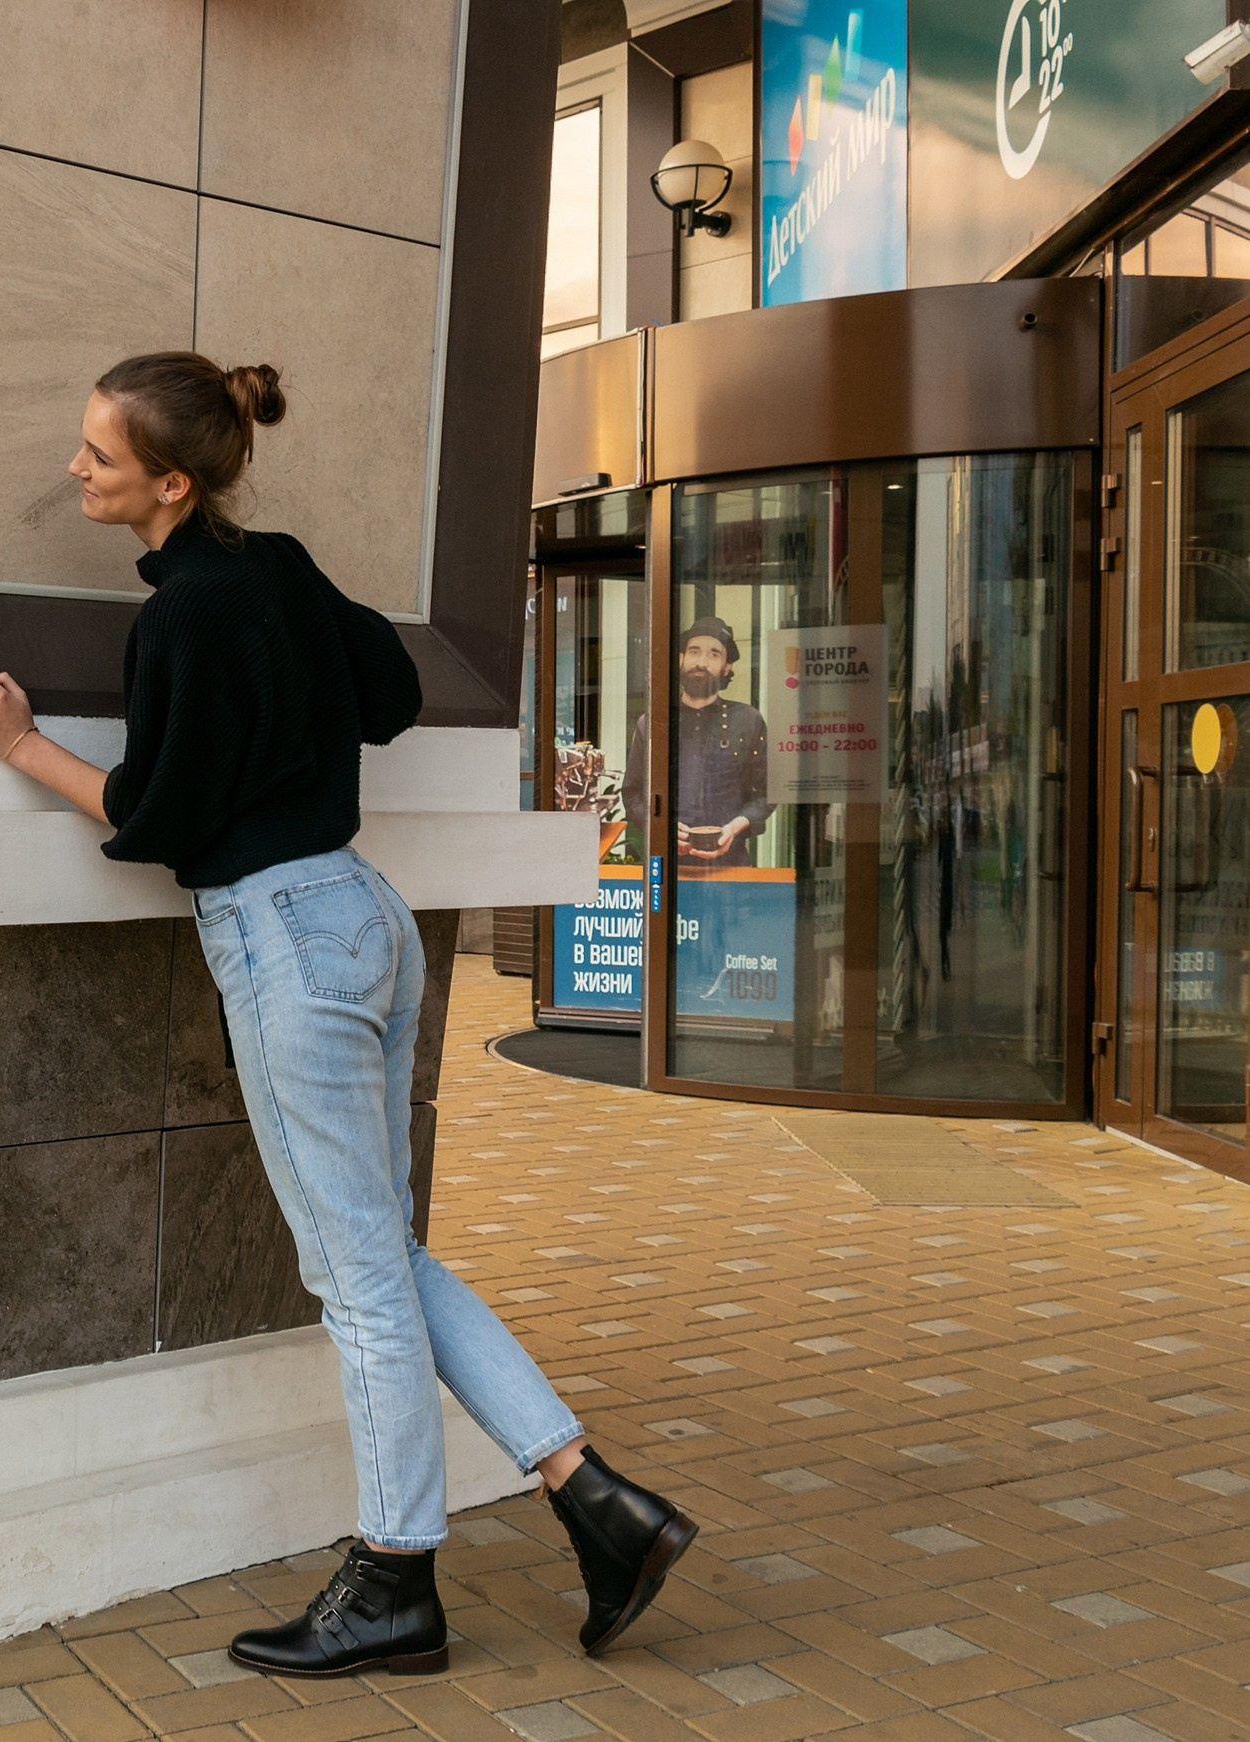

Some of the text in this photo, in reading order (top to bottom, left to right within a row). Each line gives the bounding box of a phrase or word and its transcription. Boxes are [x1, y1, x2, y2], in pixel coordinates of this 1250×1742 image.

[768, 67, 896, 288] Детский мир
[805, 646, 858, 661] ЦЕНТР
[805, 661, 870, 677] ГОРОДА
[789, 723, 865, 736] ЕЖЕДНЕВНО
[777, 740, 819, 752] 10:00
[834, 739, 878, 752] 22:00
[725, 953, 778, 971] Coffee Set
[573, 972, 633, 994] жизни
